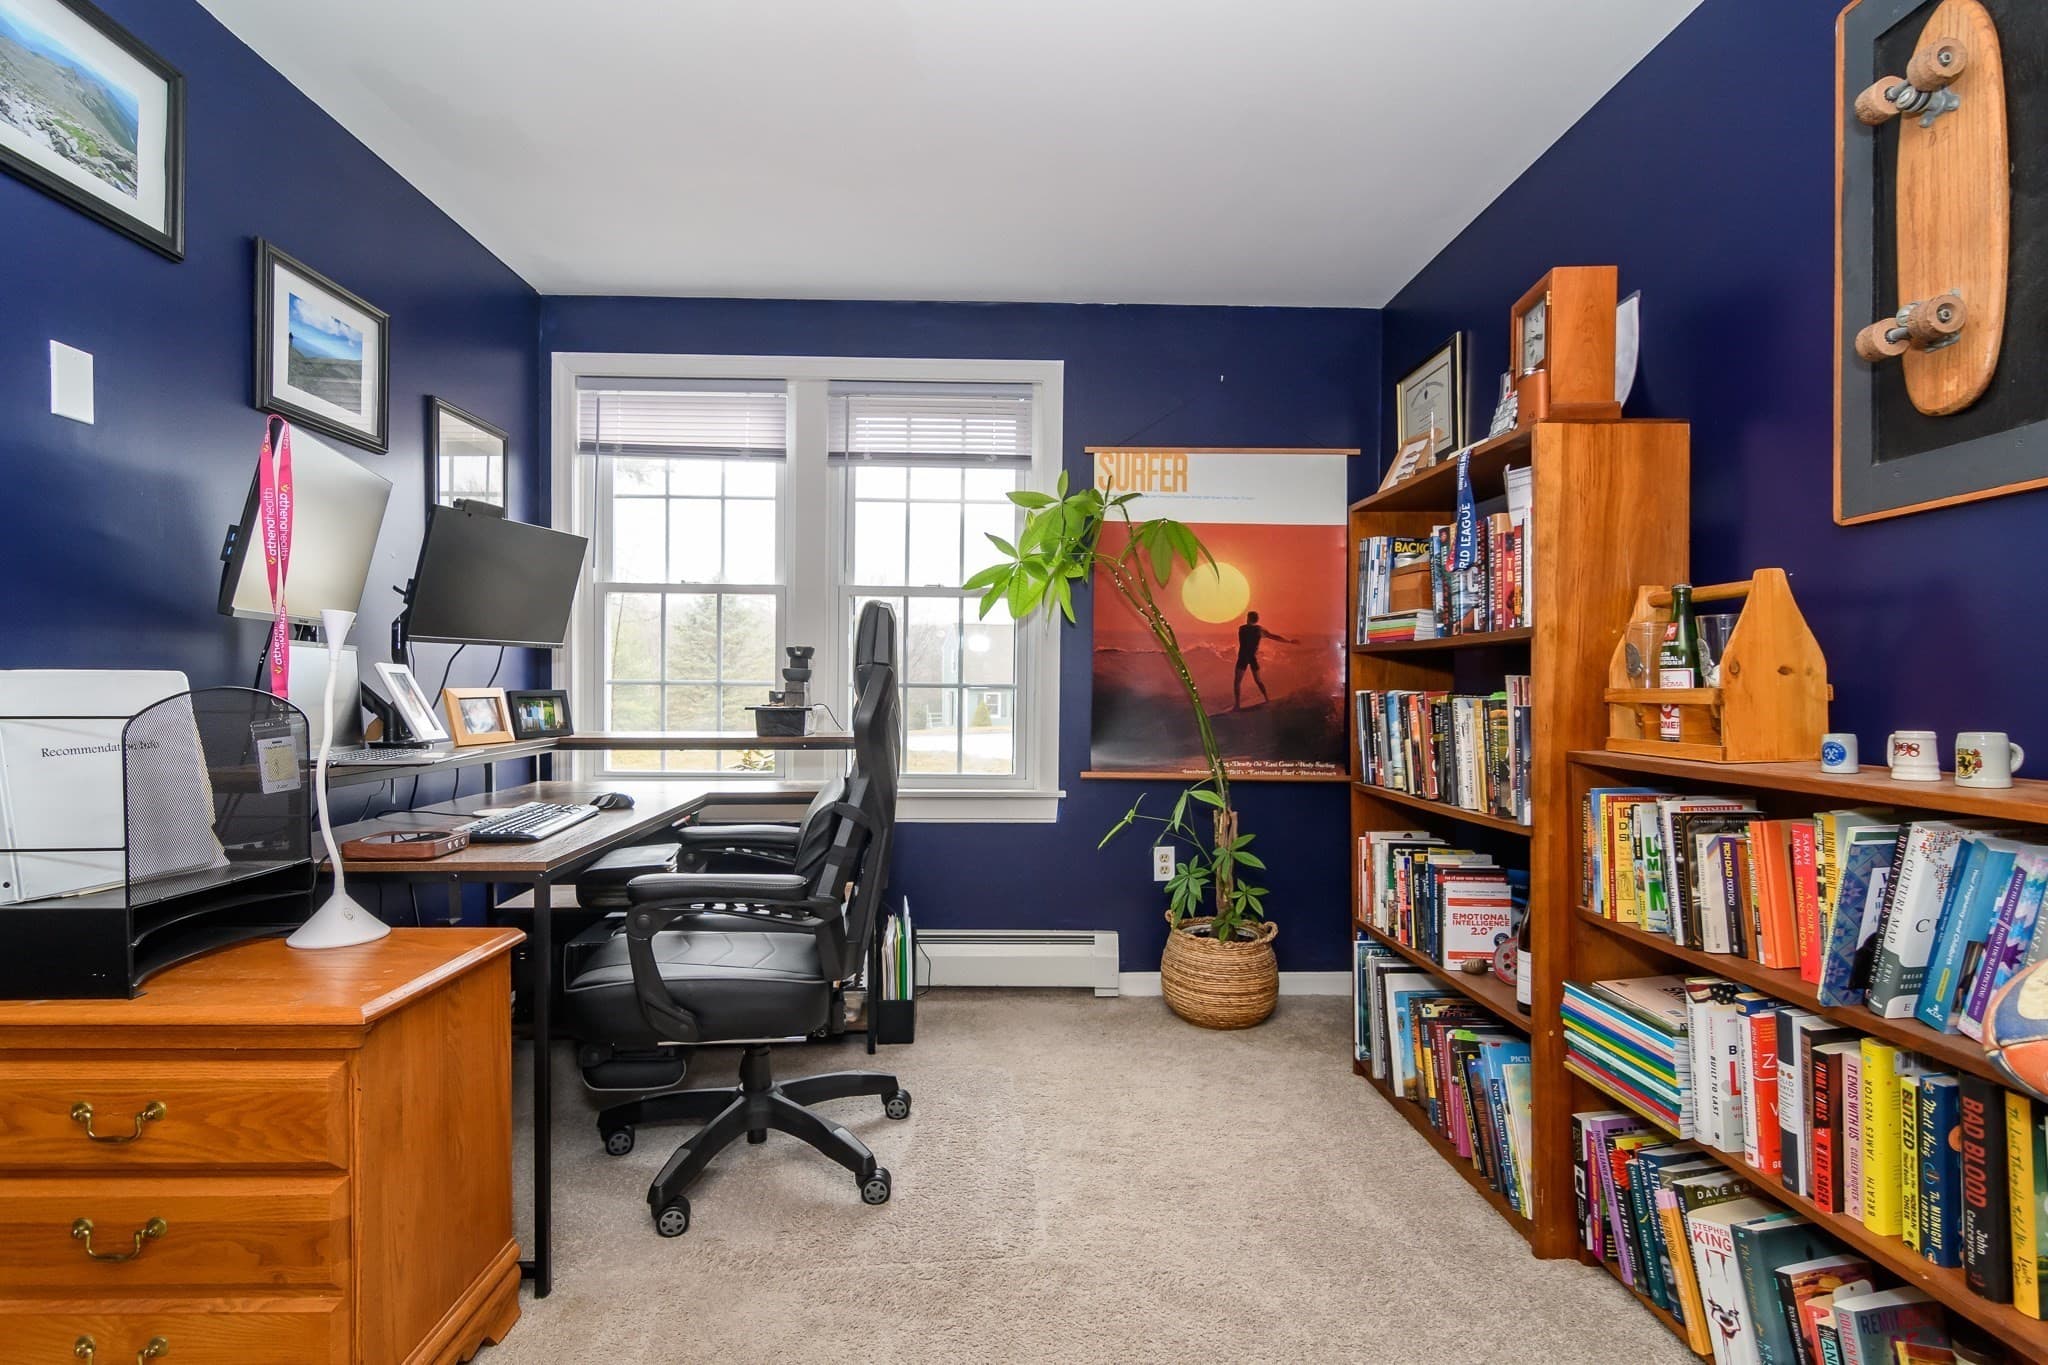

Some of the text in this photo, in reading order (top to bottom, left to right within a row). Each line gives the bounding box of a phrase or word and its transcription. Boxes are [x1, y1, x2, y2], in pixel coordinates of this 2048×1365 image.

[1098, 453, 1188, 493] SURFER
[264, 488, 276, 556] athenahealth
[280, 493, 290, 560] athenahealth
[1461, 503, 1472, 547] LEAGUE
[41, 741, 138, 758] Recommendaton
[1794, 837, 1802, 866] MAAS
[1801, 833, 1810, 865] SARAH
[1826, 831, 1837, 890] RACING WEIGHT
[1891, 834, 1906, 878] BRITNEY
[1724, 860, 1732, 877] DAD
[1969, 868, 1978, 884] Your
[2013, 872, 2023, 890] WHAT
[1883, 882, 1896, 919] SPEARS
[1888, 844, 1917, 943] the CULTURE MAP
[1959, 883, 1974, 919] Pregnancy
[2002, 896, 2015, 922] EXPECT
[1452, 913, 1510, 921] EMOTIONAL
[1471, 927, 1488, 936] 2.0
[1796, 877, 1808, 957] THORNS ROSES
[1806, 902, 1814, 935] COURT
[1878, 922, 1886, 934] THE
[1954, 919, 1964, 933] and
[1872, 937, 1883, 962] WOMAN
[1947, 932, 1960, 965] Childbirth
[1995, 926, 2005, 945] WHEN
[1874, 955, 1885, 983] MEYER
[1882, 963, 1893, 983] ERIN
[1978, 965, 1992, 998] EXPECTING
[1709, 1055, 1717, 1079] BUILT
[1752, 1049, 1758, 1058] TO
[1711, 1082, 1717, 1092] TO
[1492, 1082, 1510, 1165] Not Without Peril
[1815, 1061, 1830, 1206] FINAL GIRLS RILEY SAGER
[1847, 1063, 1860, 1201] IT ENDS WITH US COLLEEN HOOVER
[1901, 1088, 1914, 1149] BLITZED
[1919, 1097, 1937, 1157] Matt Haig
[1647, 1159, 1656, 1168] A
[1864, 1079, 1876, 1217] BREATH JAMES NESTOR
[1962, 1095, 1986, 1208] BAD BLOOD
[1604, 1175, 1615, 1207] STRONGER
[1638, 1157, 1660, 1242] HANYA YANAGIHARA
[1677, 1196, 1686, 1213] DAVE
[1697, 1186, 1728, 1200] DAVE
[1615, 1191, 1631, 1239] IN THE DARK
[1630, 1166, 1655, 1279] CHANEL MILLER KNOW MY NAME
[1909, 1193, 1917, 1229] NORMAN
[1920, 1194, 1928, 1233] LIBRARY
[1929, 1190, 1941, 1249] The MIDNIGHT
[1692, 1222, 1730, 1238] STEPHEN
[1693, 1230, 1732, 1252] KING
[1965, 1209, 1977, 1265] Carreyrou
[1975, 1228, 1988, 1255] John
[1705, 1249, 1733, 1281] IT
[1839, 1312, 1857, 1359] COLLEEN
